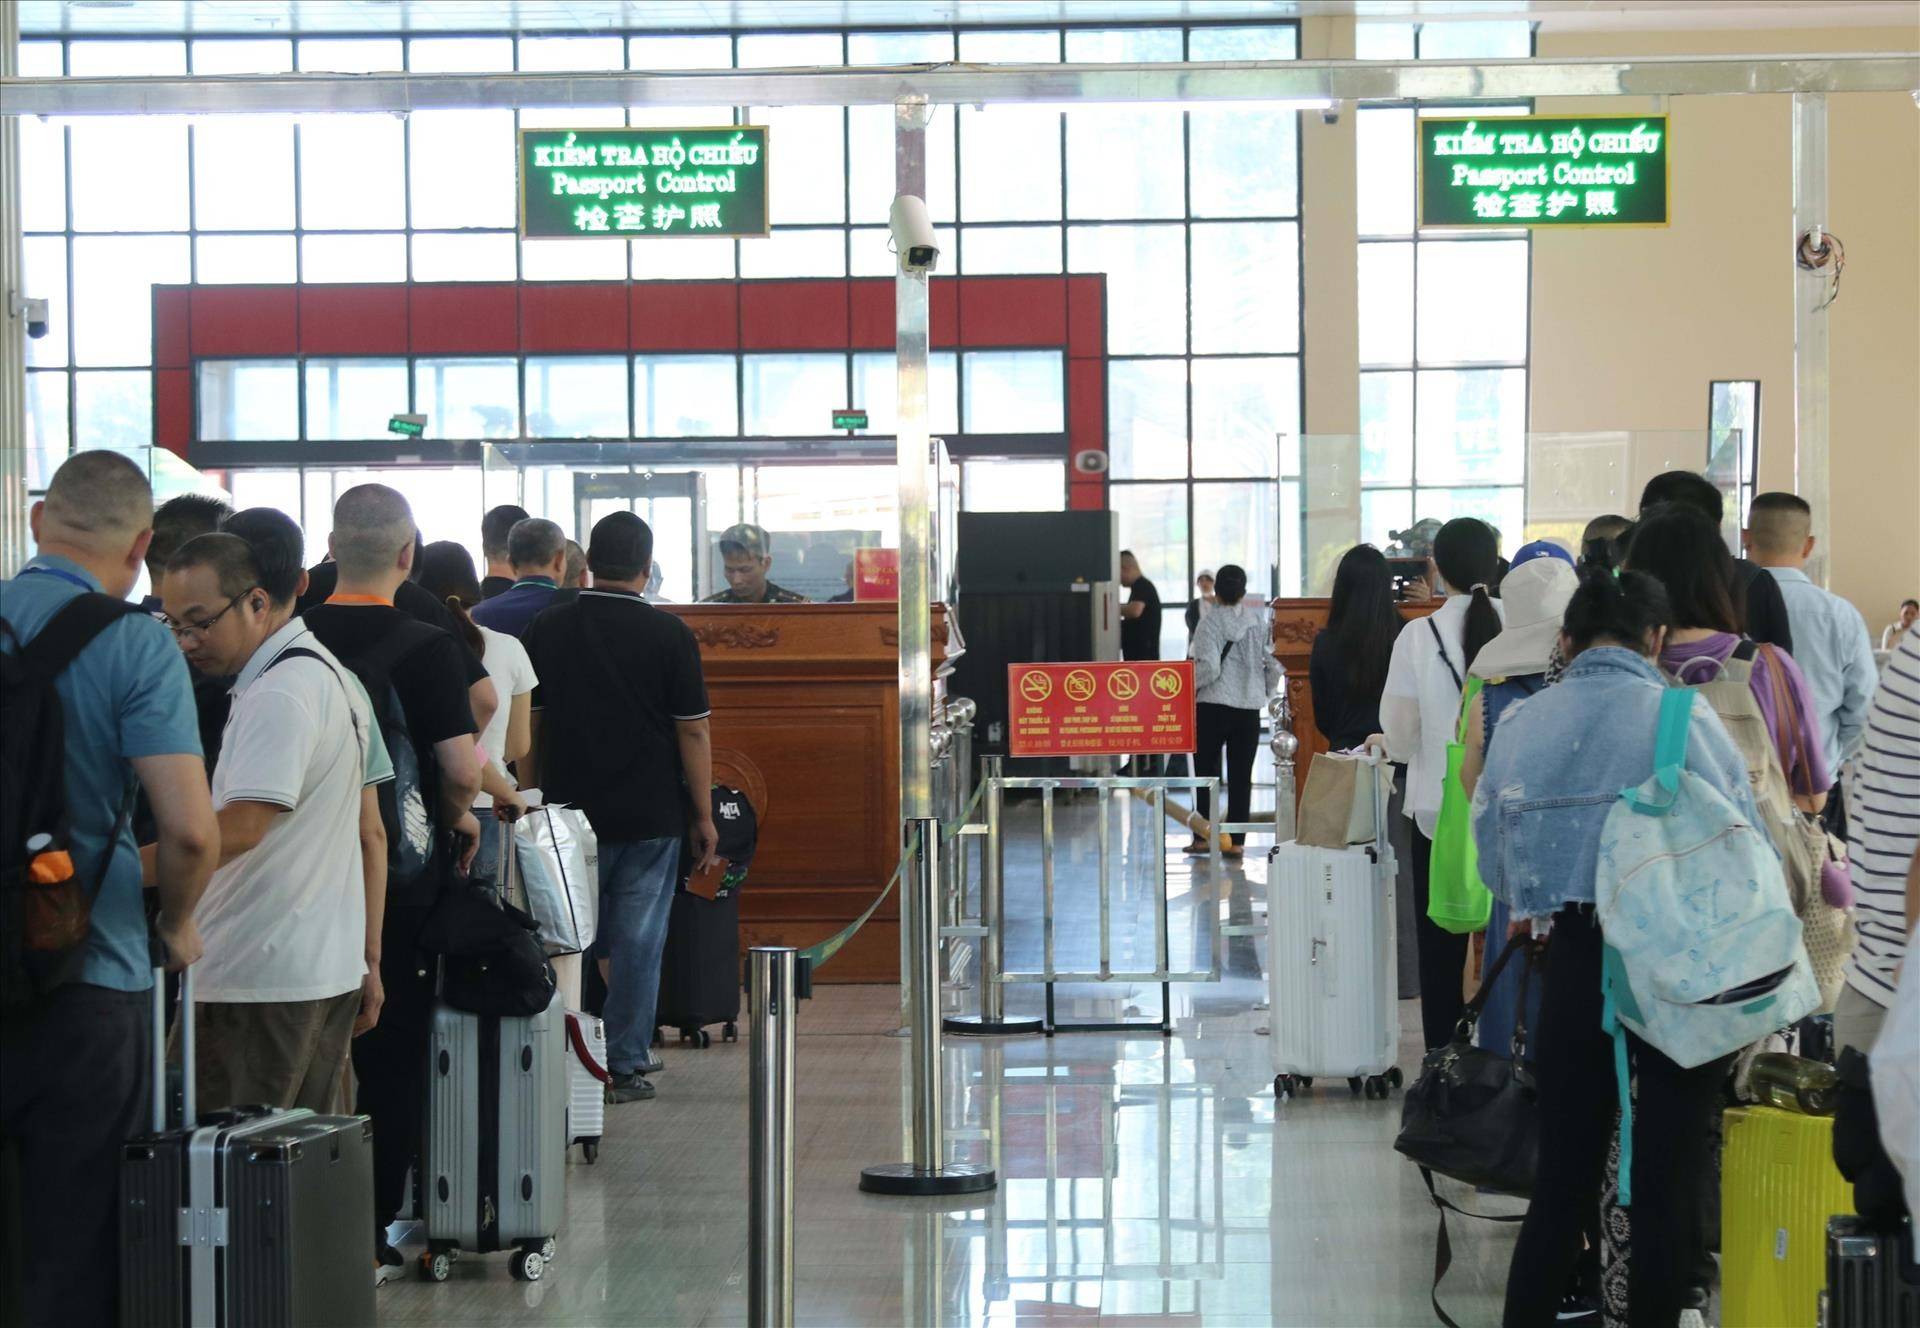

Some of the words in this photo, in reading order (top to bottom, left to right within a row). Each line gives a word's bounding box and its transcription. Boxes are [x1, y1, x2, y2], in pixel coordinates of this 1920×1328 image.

[534, 132, 597, 167] KIỂM
[601, 145, 649, 166] TRA
[651, 137, 686, 171] HỘ
[689, 131, 759, 165] CHIẾU
[1433, 121, 1496, 155] KIỂM
[1500, 134, 1548, 154] TRA
[1550, 126, 1585, 159] HỘ
[1588, 123, 1661, 154] CHIẾU
[552, 171, 647, 200] Passport
[656, 169, 736, 193] Control
[1451, 163, 1549, 191] Passport
[1553, 161, 1636, 185] Control
[574, 203, 722, 231] 检查护照
[1473, 190, 1618, 217] 检查护照
